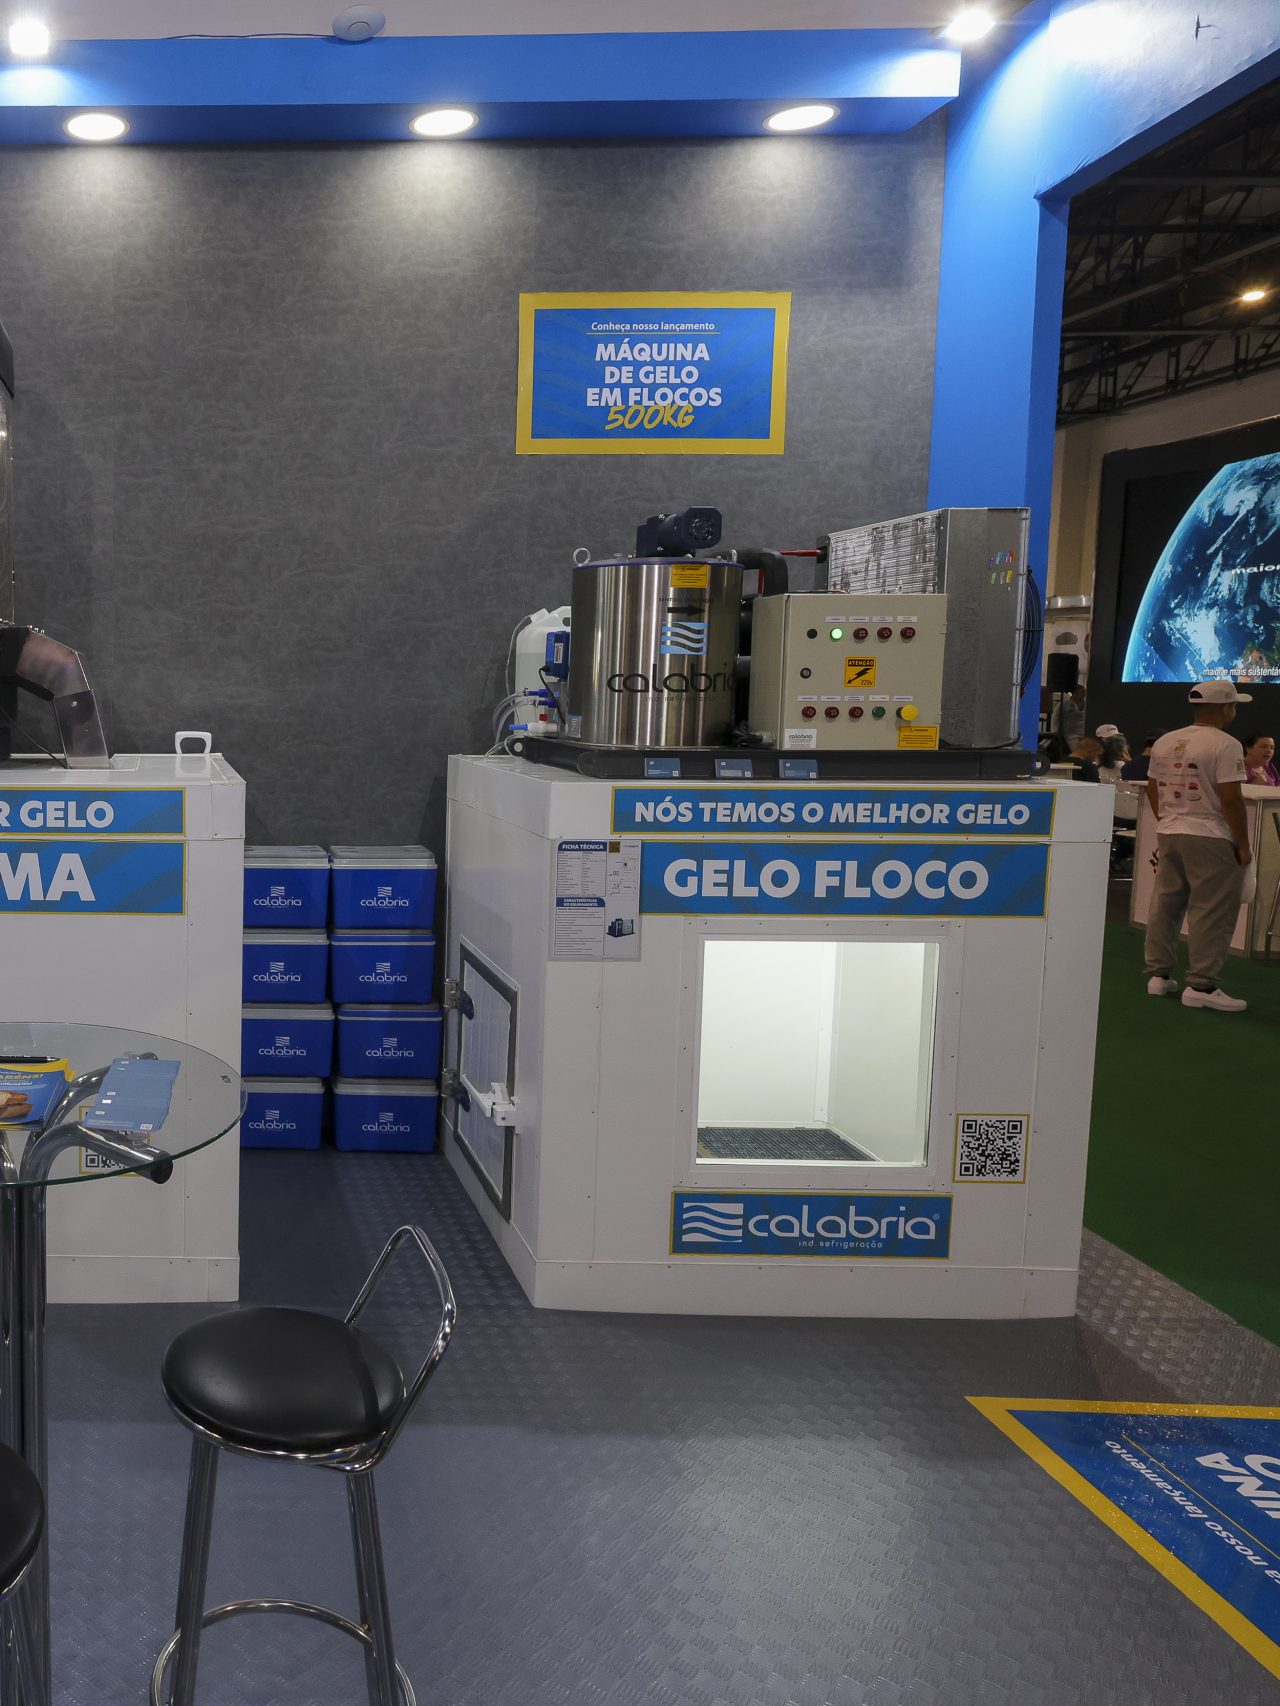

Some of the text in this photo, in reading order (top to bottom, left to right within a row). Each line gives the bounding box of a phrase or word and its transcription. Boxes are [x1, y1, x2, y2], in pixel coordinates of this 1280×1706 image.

[591, 321, 716, 334] Conheça nosso lançamento
[595, 338, 711, 363] MÁQUINA
[604, 366, 699, 384] DE GELO
[586, 388, 723, 407] EM FLOCOS
[605, 403, 695, 430] 500KG
[19, 801, 115, 829] GELO
[634, 796, 1030, 825] NÓS TEMOS O MELHOR GELO
[663, 858, 989, 900] GELO FLOCO
[253, 896, 302, 907] calabria
[360, 896, 409, 908] calabria
[252, 972, 301, 983] calabria
[359, 973, 408, 984] calabria
[258, 1046, 307, 1057] calabria
[365, 1047, 414, 1058] calabria
[248, 1119, 297, 1131] calabria
[362, 1122, 410, 1133] calabria
[1104, 1439, 1209, 1518] lançamento
[1205, 1521, 1269, 1565] nosso
